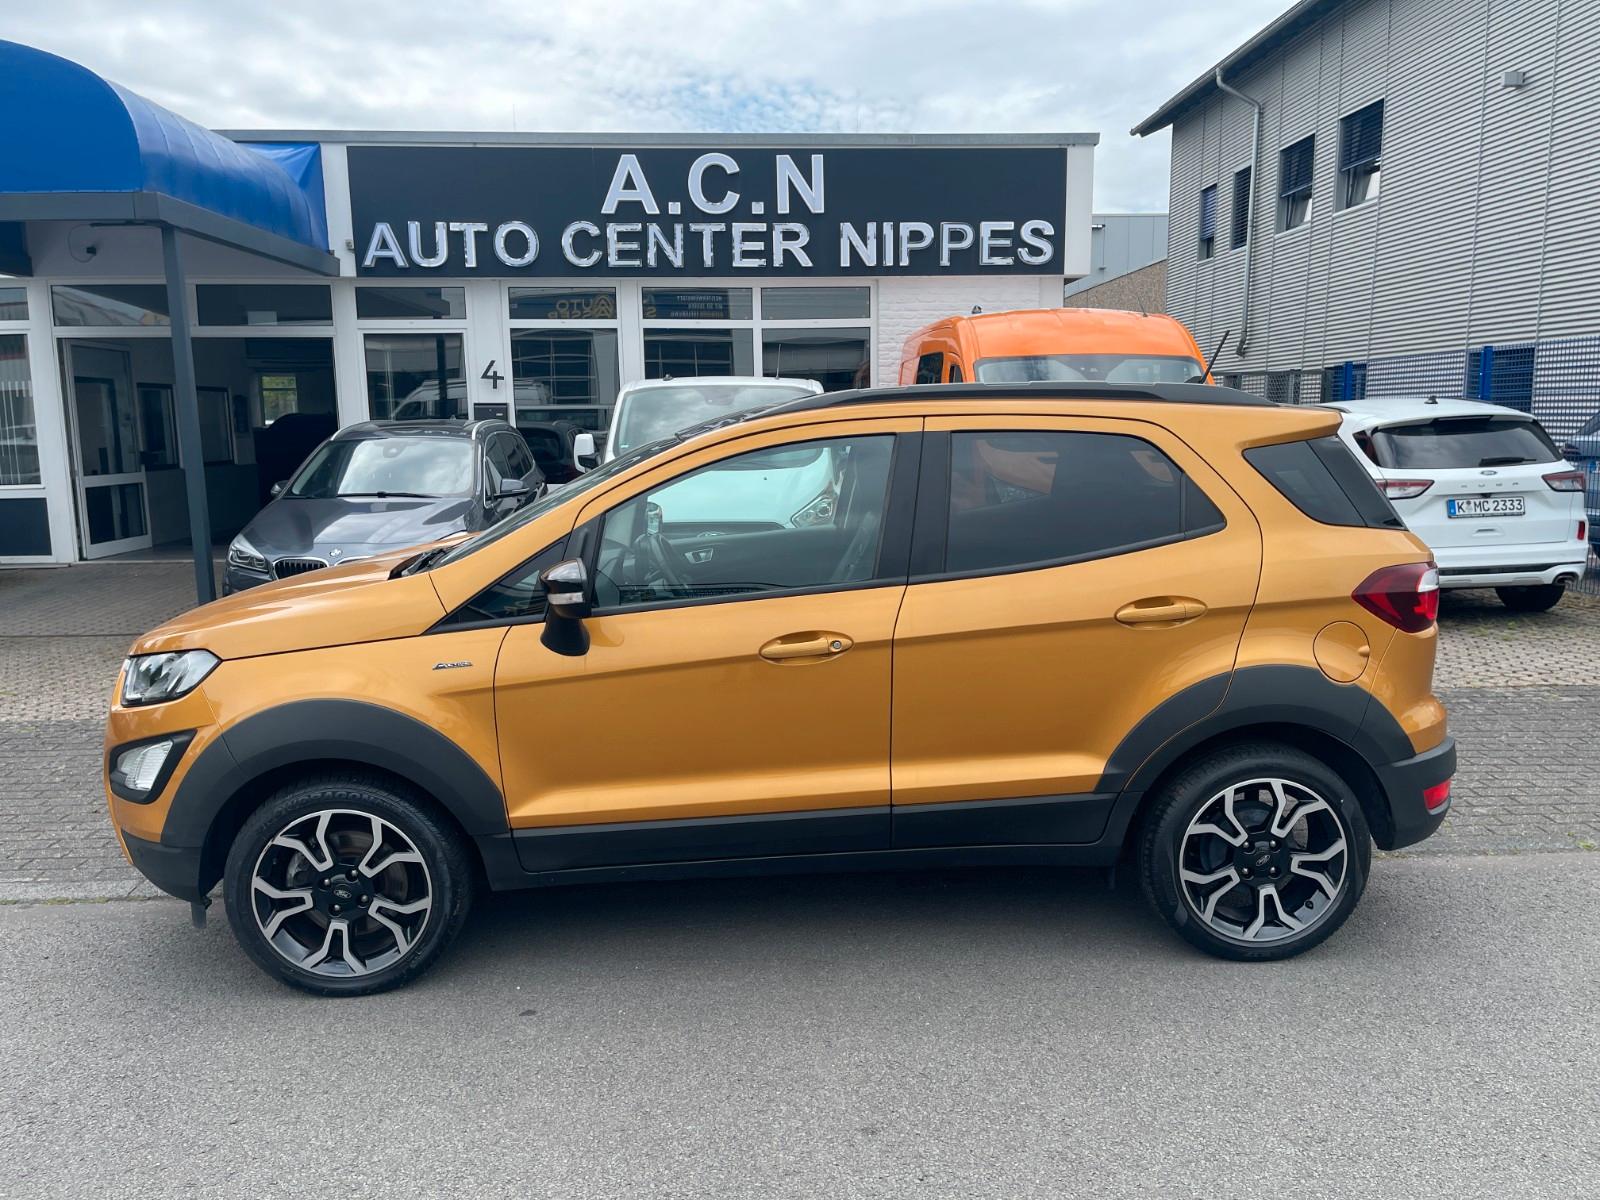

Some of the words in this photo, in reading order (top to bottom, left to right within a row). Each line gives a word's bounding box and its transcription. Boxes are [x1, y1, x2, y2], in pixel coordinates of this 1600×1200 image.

[600, 152, 825, 215] A.C.N
[361, 220, 540, 268] AUTO
[561, 220, 814, 268] CENTER
[840, 219, 1055, 267] NIPPES
[481, 360, 504, 389] 4
[1457, 501, 1466, 513] K
[1474, 500, 1490, 512] MC
[1492, 499, 1523, 512] 2333
